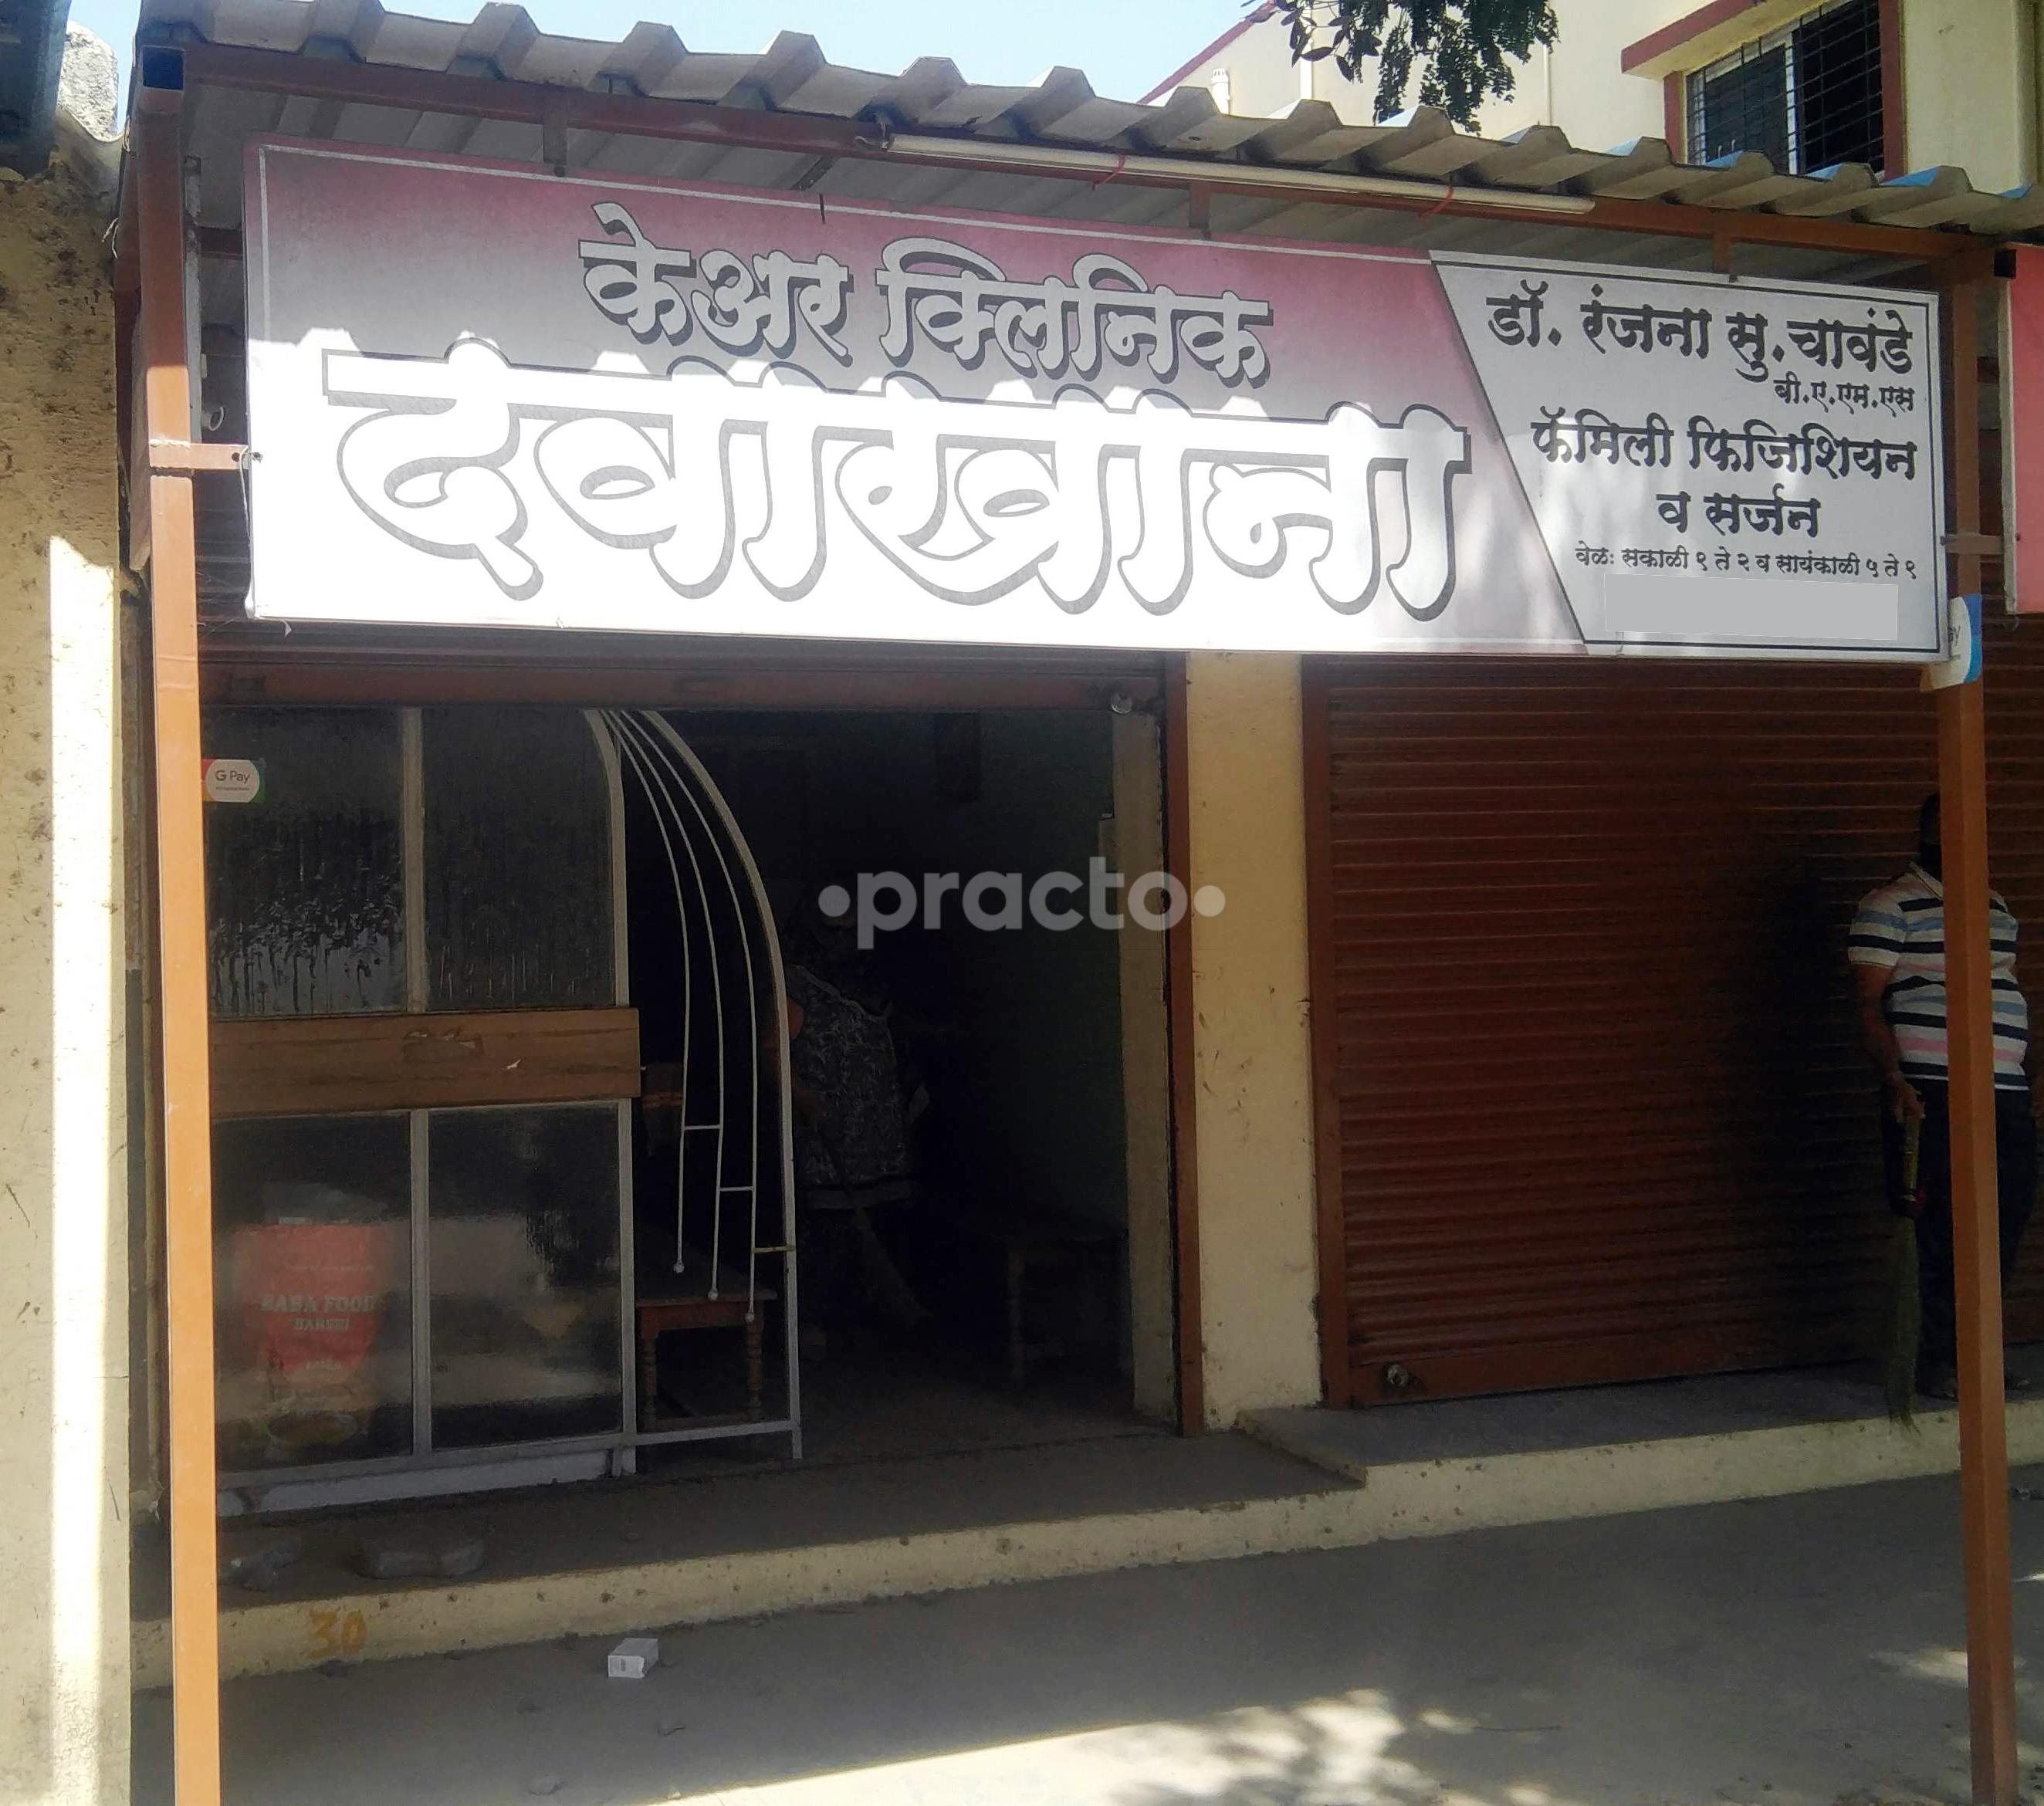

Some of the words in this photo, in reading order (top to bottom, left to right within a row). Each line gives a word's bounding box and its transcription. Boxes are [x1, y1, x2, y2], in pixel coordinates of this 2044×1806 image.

[578, 201, 854, 367] केअर
[875, 235, 1274, 388] क्लिनिक
[1485, 279, 1562, 348] डॉ.
[1579, 283, 1713, 360] रंजना
[321, 337, 1472, 622] दवाखाना
[1686, 414, 1918, 481] फिजिशियन
[1656, 490, 1691, 534] व
[1702, 482, 1822, 538] सर्जन
[1621, 544, 1690, 570] सकाळी
[1714, 546, 1731, 571] ते
[1737, 553, 1750, 571] २
[1755, 553, 1771, 573] व
[1775, 549, 1861, 577] सायंकाळी
[1866, 558, 1879, 578] ५
[1883, 553, 1900, 577] ते
[229, 770, 250, 784] Pay
